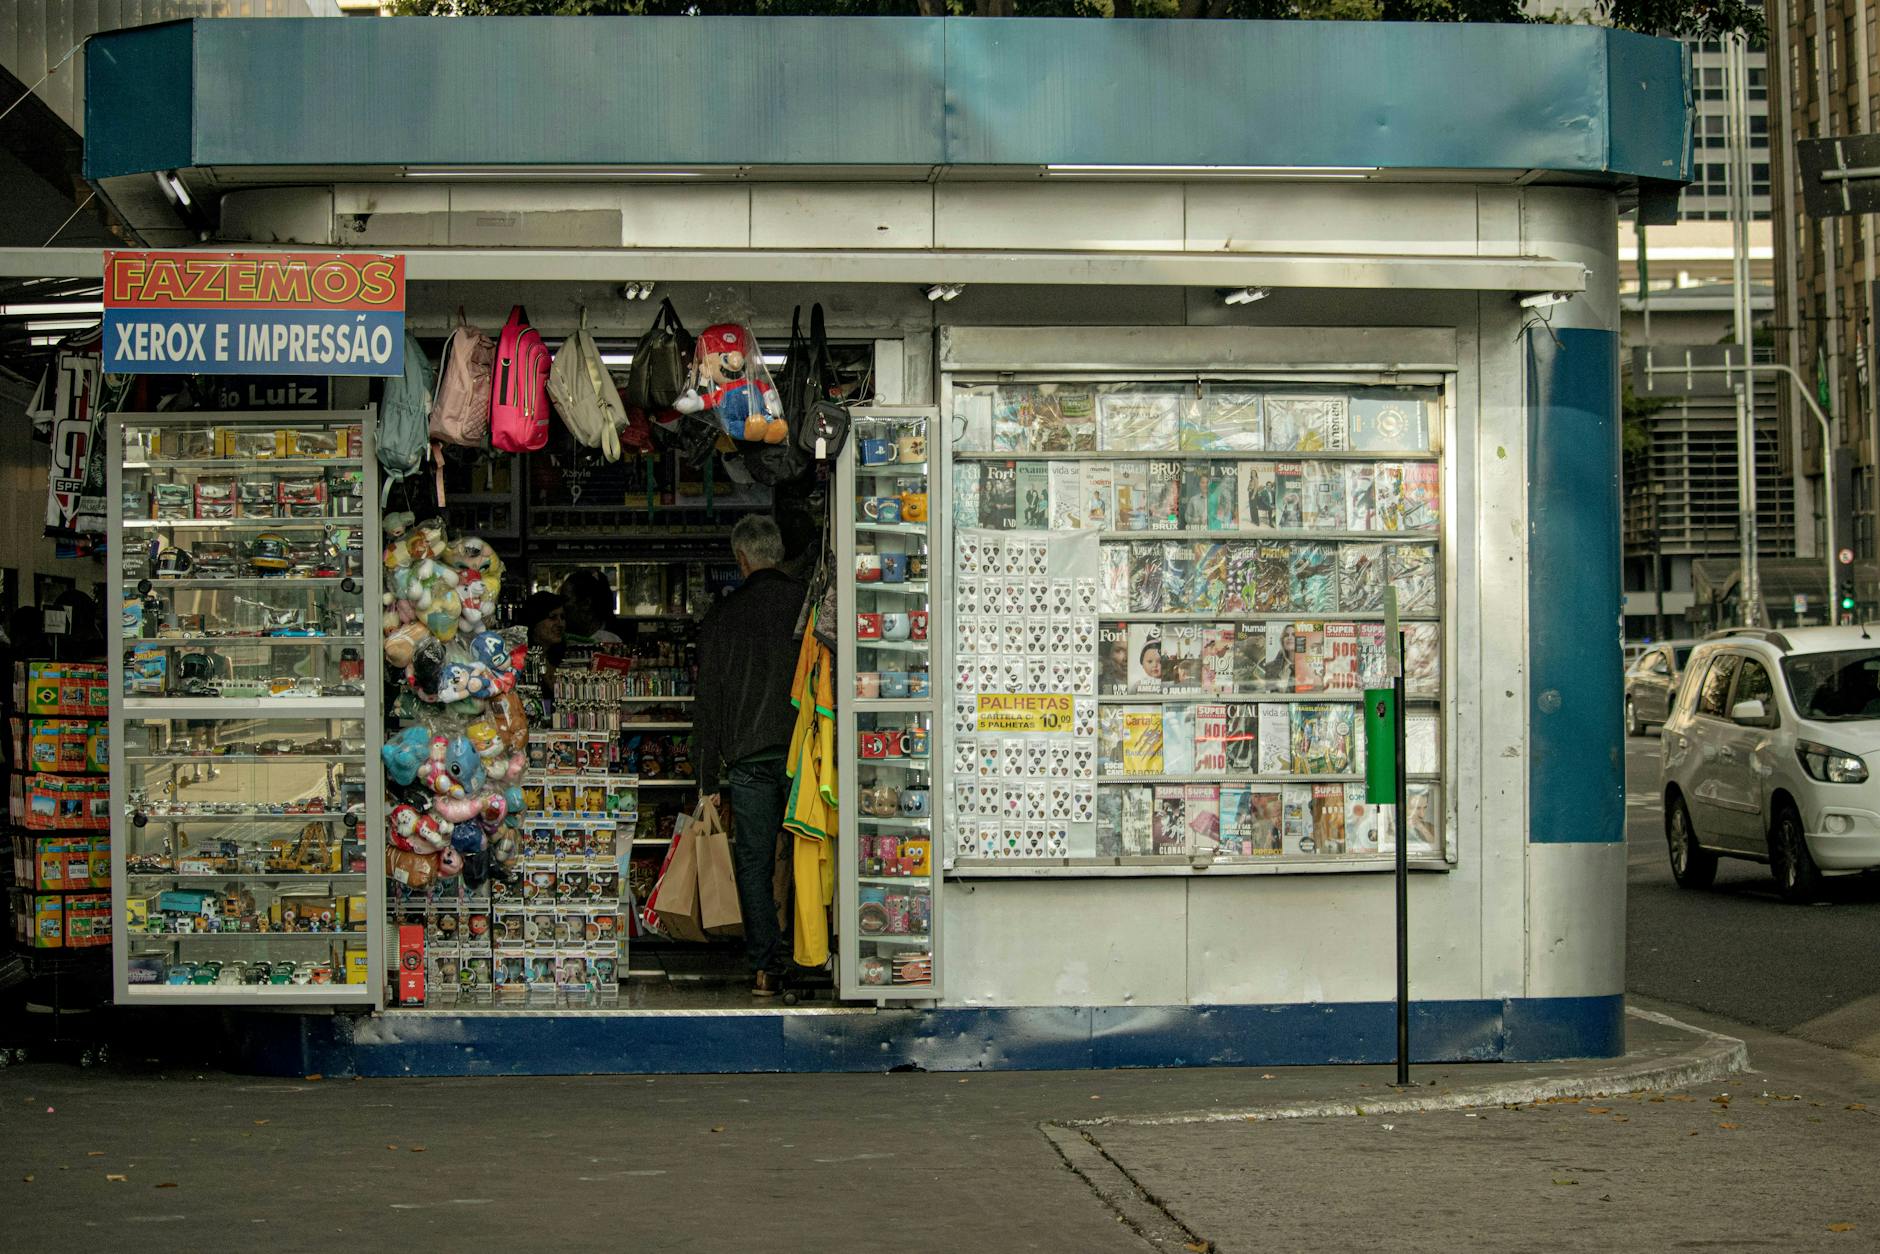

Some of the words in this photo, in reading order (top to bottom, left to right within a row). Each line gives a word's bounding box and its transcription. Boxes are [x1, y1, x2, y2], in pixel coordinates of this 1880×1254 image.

[112, 259, 397, 304] FAZEMOS
[114, 323, 207, 361] XEROX
[215, 324, 229, 361] E
[238, 314, 393, 364] IMPRESSÃO
[249, 382, 318, 406] Luiz
[1053, 466, 1069, 475] vida
[1327, 626, 1354, 634] SUPER
[980, 696, 1070, 710] PALHETAS
[1263, 709, 1278, 717] vida
[1187, 786, 1214, 797] SUPER
[1314, 786, 1342, 795] SUPER
